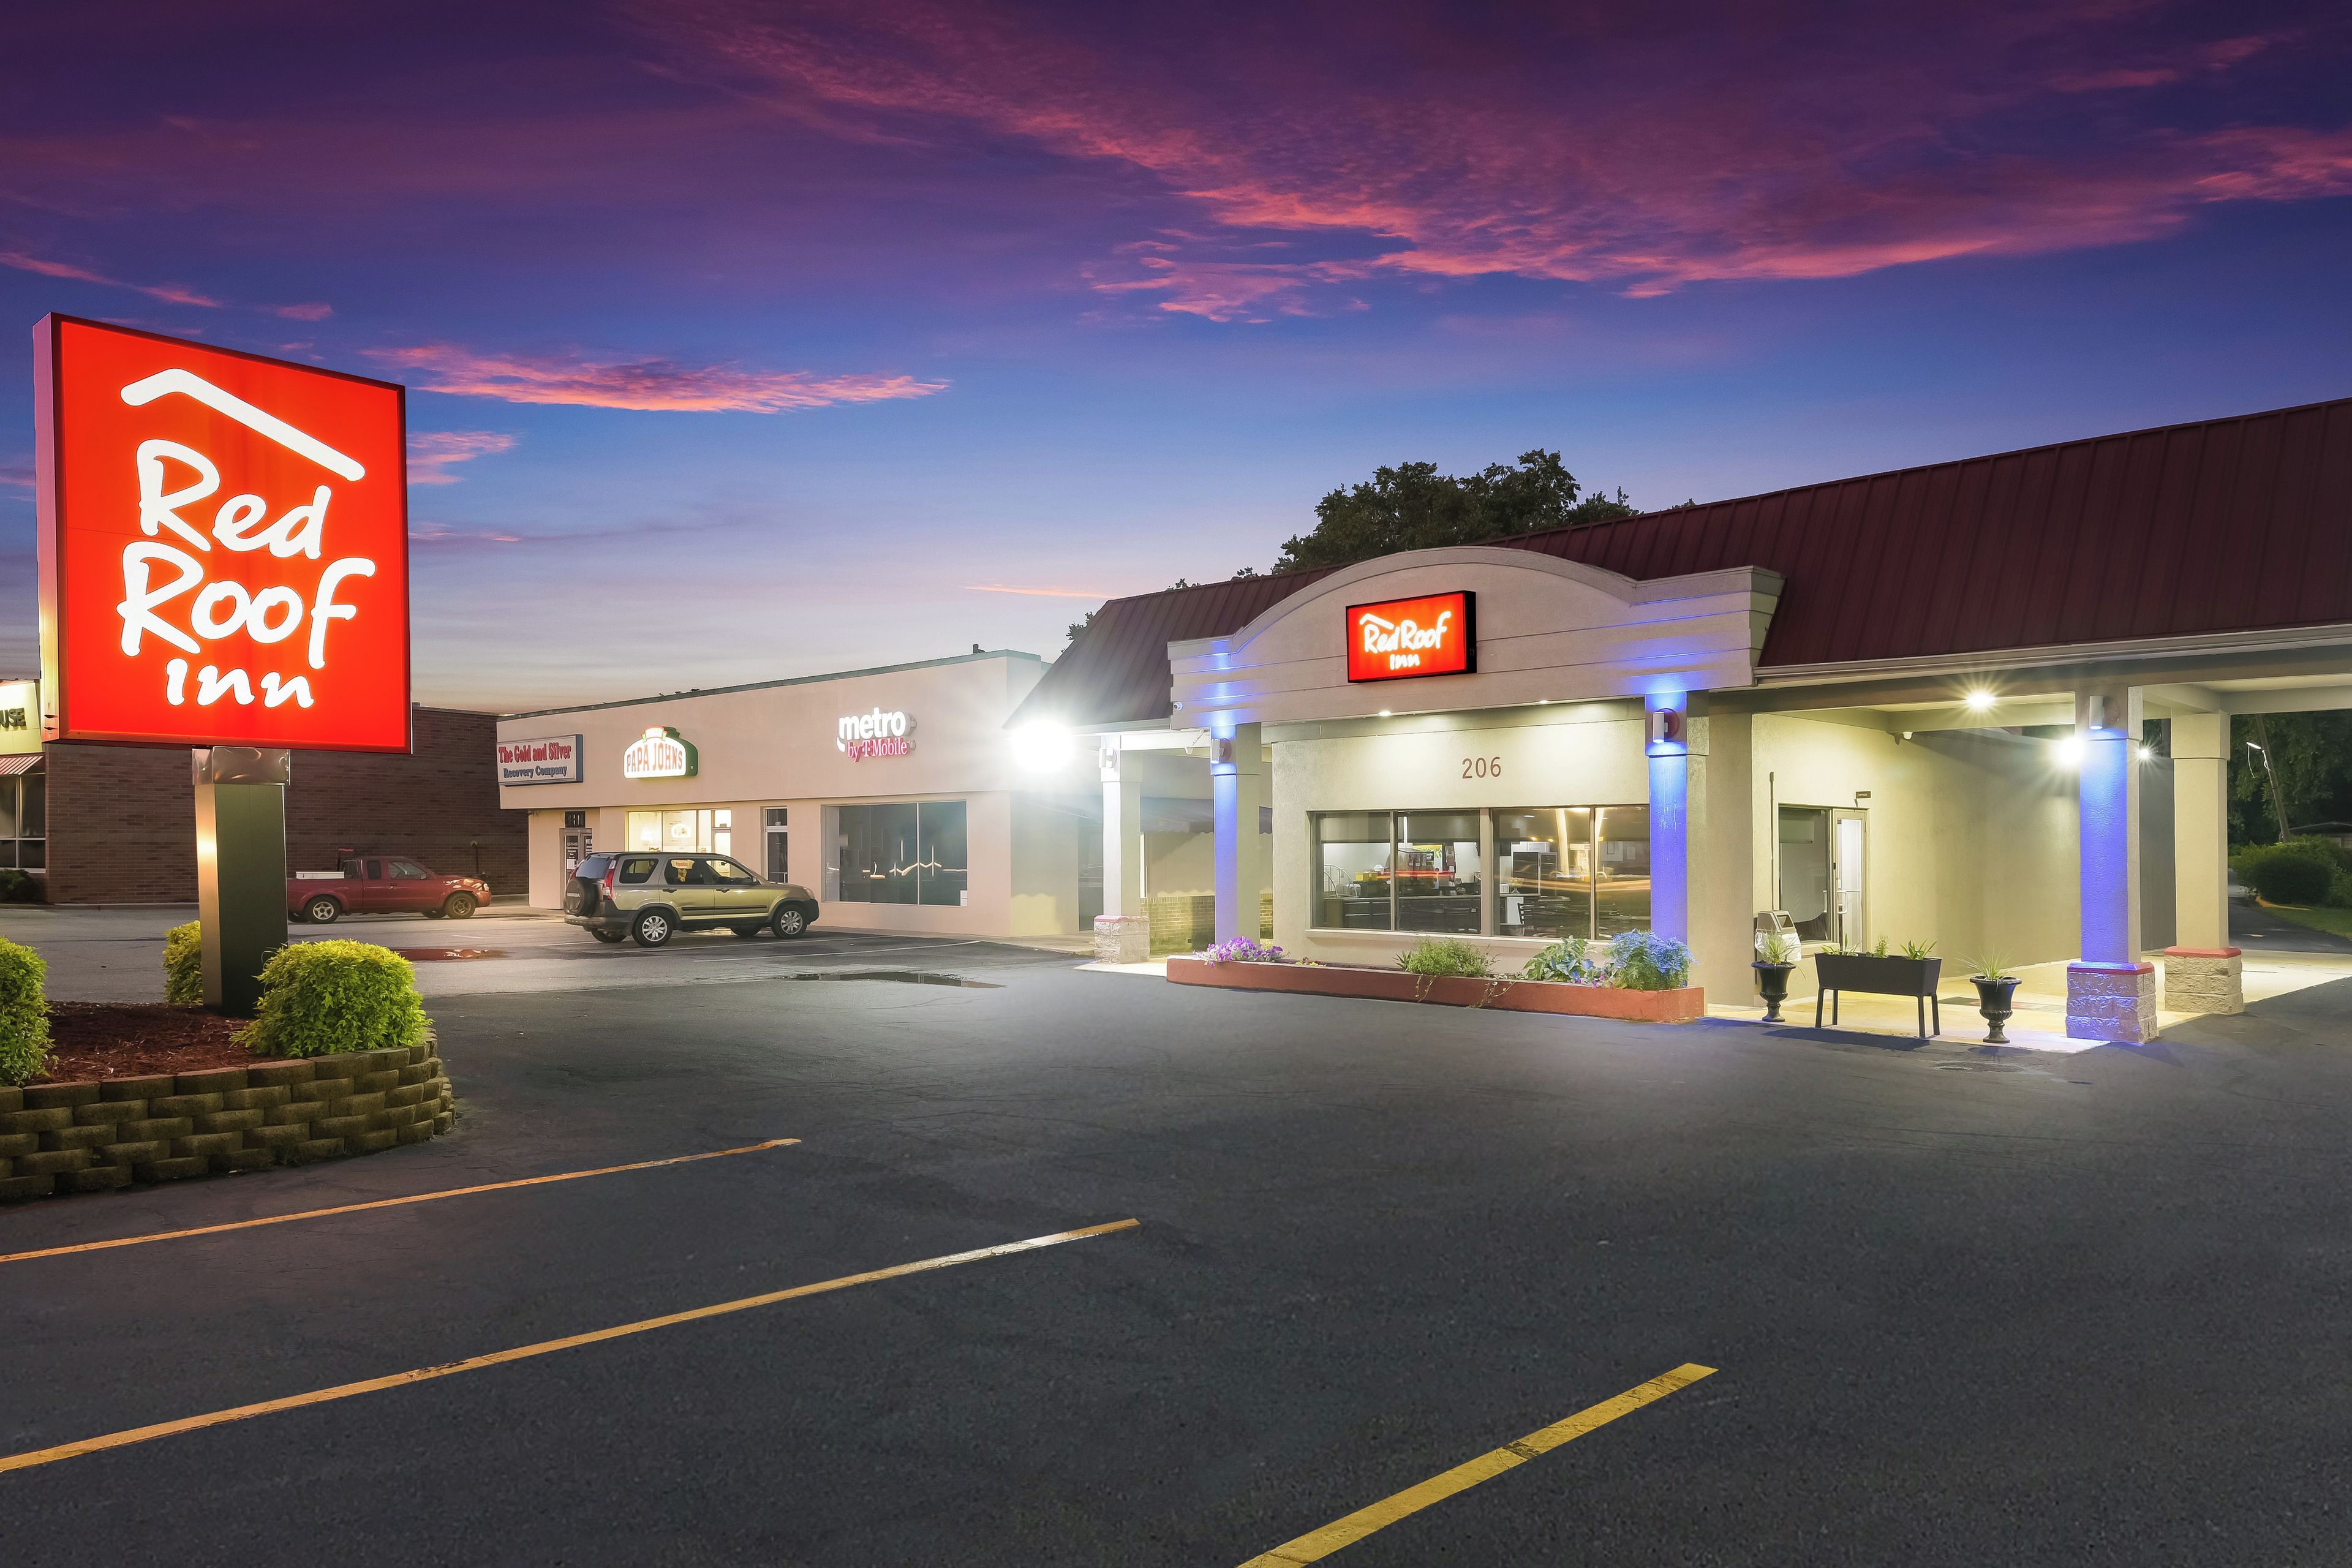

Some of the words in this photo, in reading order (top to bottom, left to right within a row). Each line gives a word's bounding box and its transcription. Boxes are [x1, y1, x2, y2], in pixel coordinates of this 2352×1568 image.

[137, 439, 331, 560] Red
[116, 541, 376, 669] Roof
[1364, 624, 1400, 654] Red
[1401, 611, 1452, 650] Roof
[0, 707, 26, 728] USE
[838, 707, 907, 741] metro
[499, 746, 513, 763] The
[514, 745, 531, 763] Gold
[532, 743, 548, 761] and
[548, 742, 571, 760] Silver
[627, 744, 649, 772] PAPA
[848, 741, 862, 762] by
[862, 737, 907, 757] T-Mobile
[503, 767, 533, 778] Recovery
[535, 765, 567, 777] Company
[1462, 756, 1501, 779] 206
